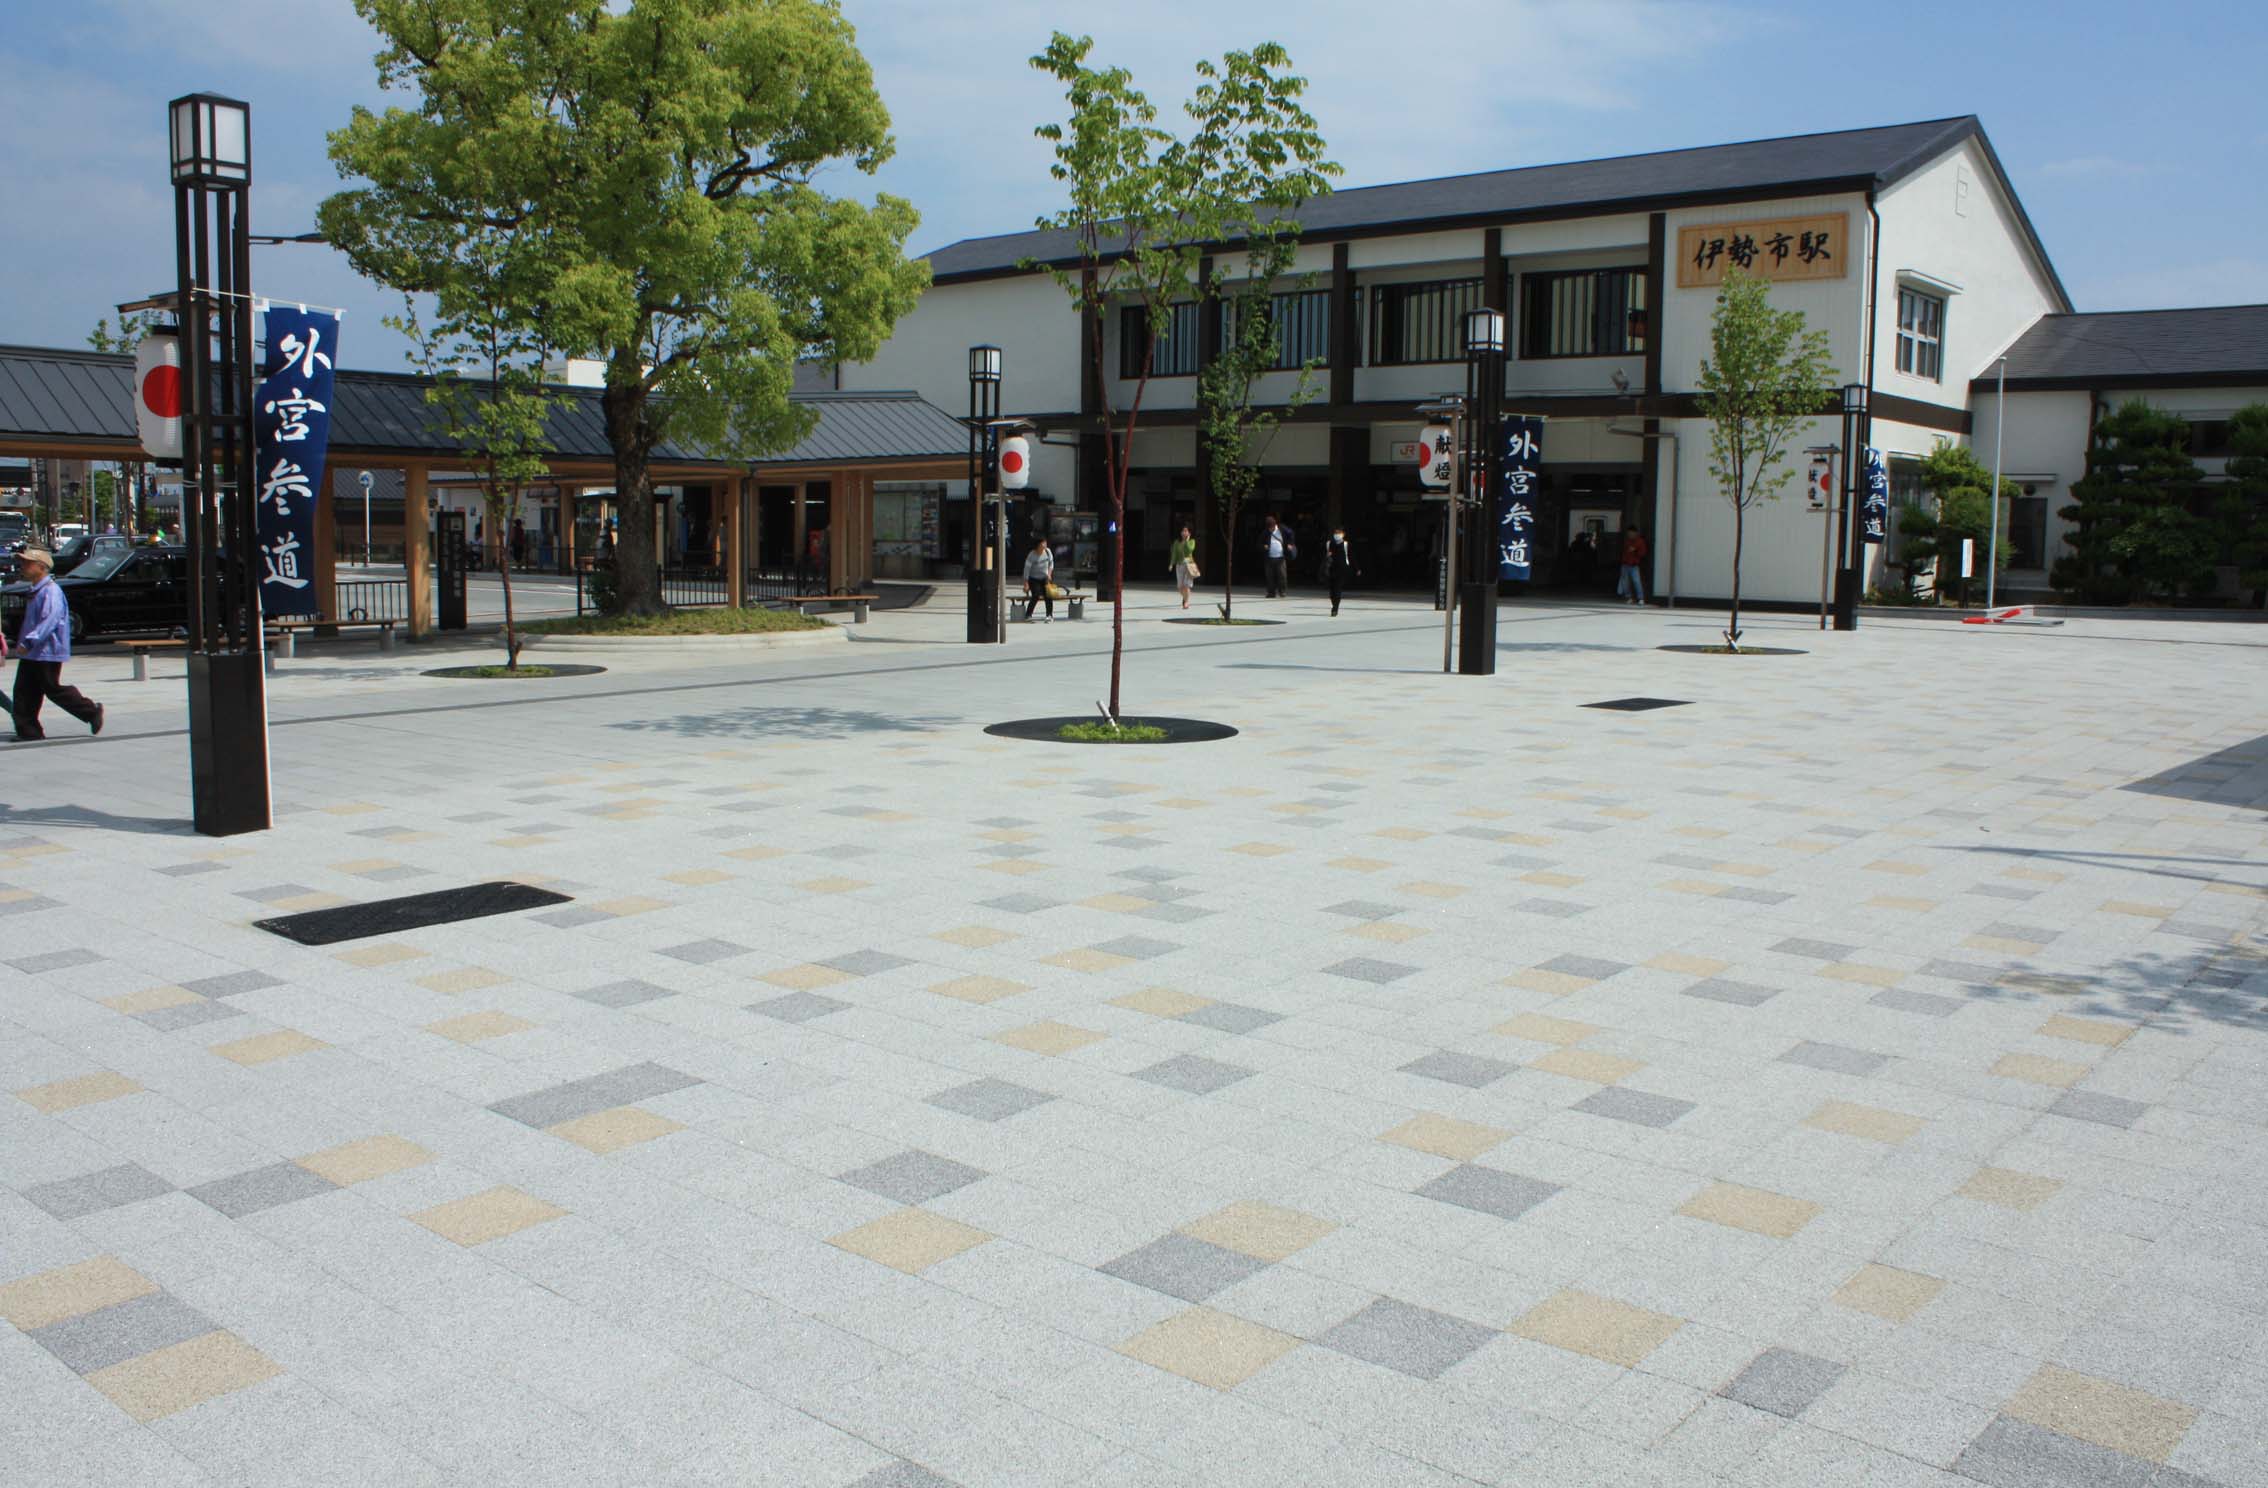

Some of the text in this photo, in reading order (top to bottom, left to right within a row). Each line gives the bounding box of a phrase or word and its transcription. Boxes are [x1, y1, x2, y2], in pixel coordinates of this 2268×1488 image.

[1693, 230, 1831, 271] 伊勢市駅
[259, 327, 332, 589] 外宮参道
[1399, 444, 1416, 457] JR
[1500, 430, 1539, 568] 外宮参道
